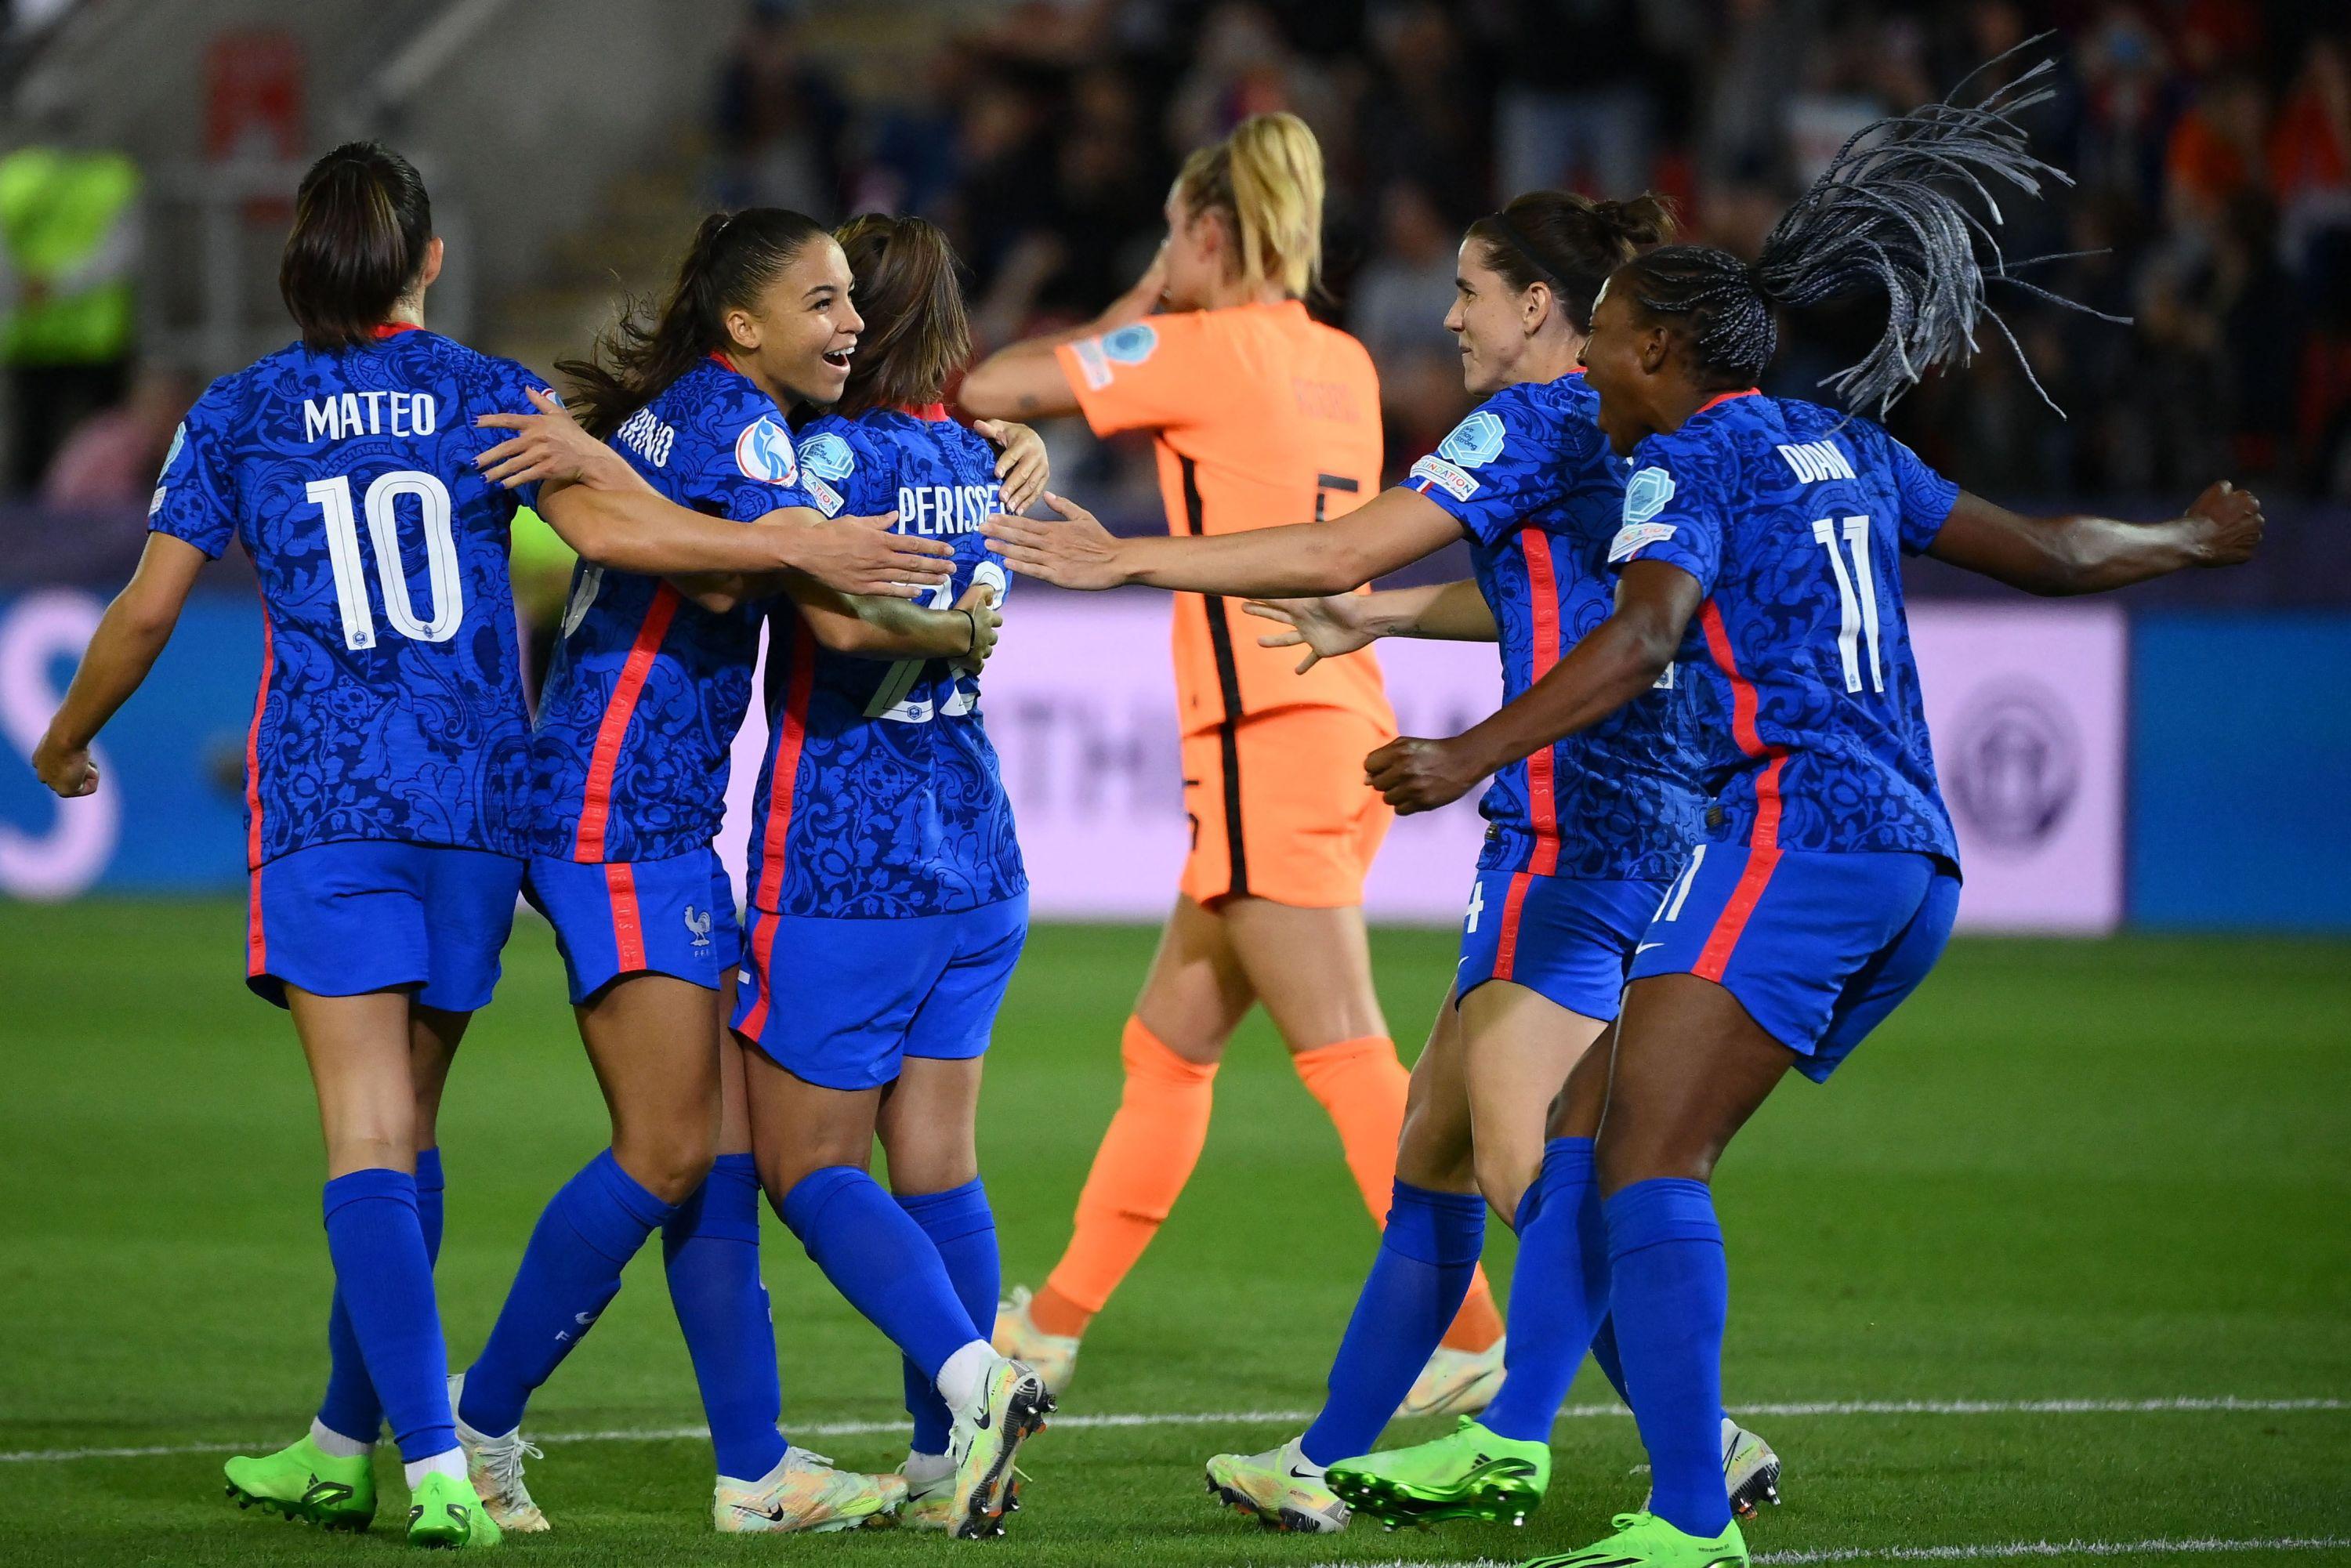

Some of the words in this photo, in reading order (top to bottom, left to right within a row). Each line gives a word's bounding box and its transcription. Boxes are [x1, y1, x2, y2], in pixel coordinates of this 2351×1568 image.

[304, 391, 436, 443] MATEO
[306, 470, 463, 651] 10
[898, 484, 1006, 534] PERISSE
[1811, 515, 1885, 693] 11
